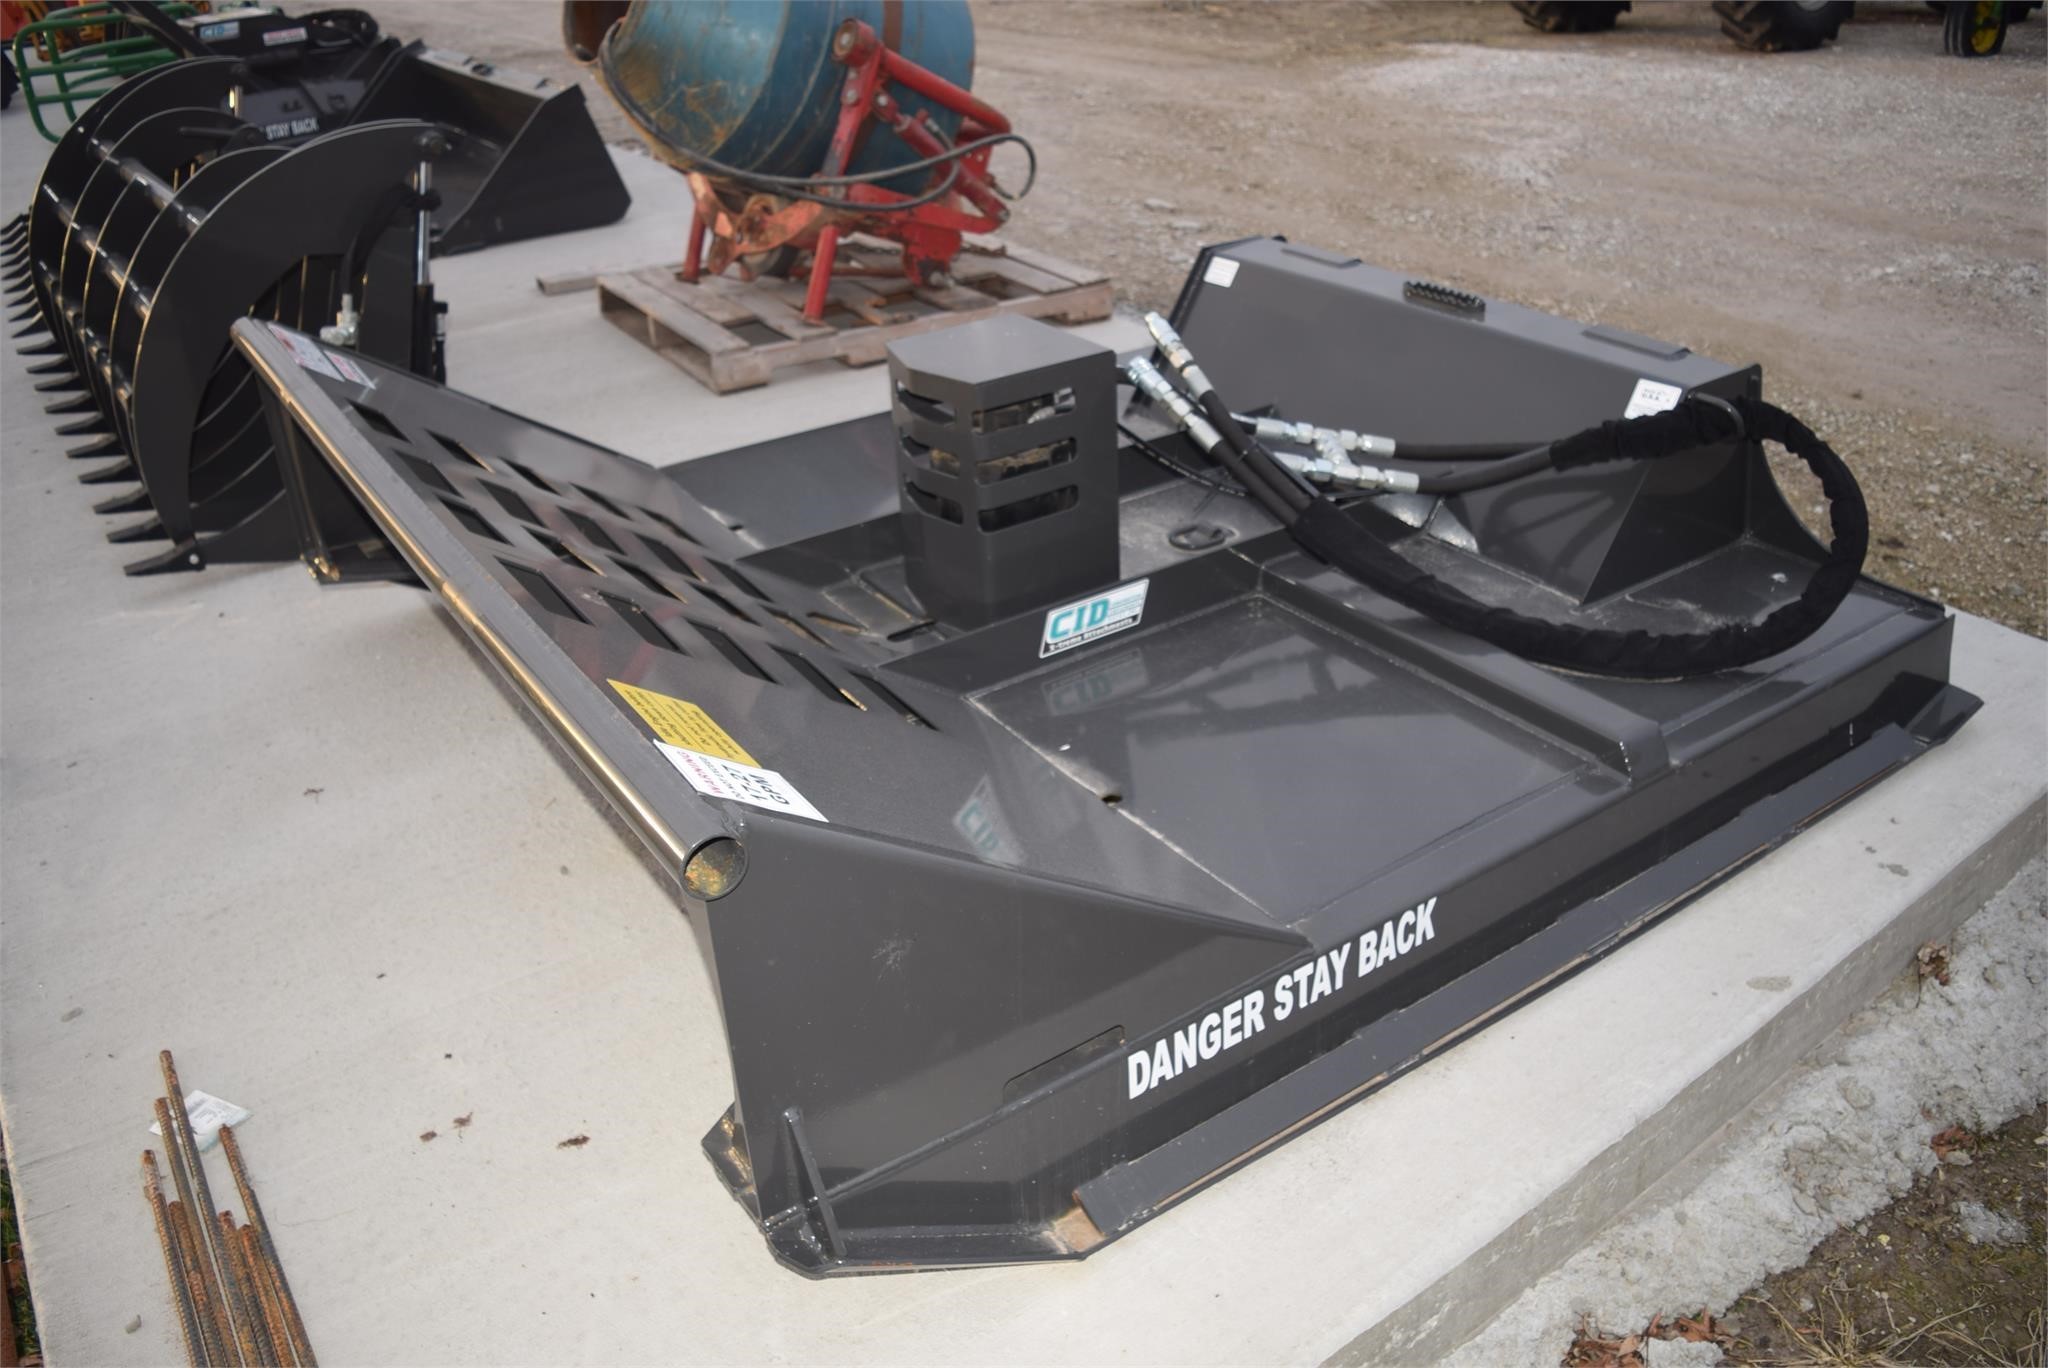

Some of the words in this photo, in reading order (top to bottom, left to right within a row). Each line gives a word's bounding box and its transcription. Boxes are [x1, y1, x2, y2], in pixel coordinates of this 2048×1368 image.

[265, 122, 290, 140] STAY
[291, 118, 318, 136] BACK
[1049, 598, 1110, 640] CID
[676, 749, 724, 795] WARNING
[747, 772, 791, 806] GPM
[1128, 990, 1265, 1099] DANGER
[1273, 943, 1351, 1021] STAY
[1358, 896, 1437, 978] BACK
